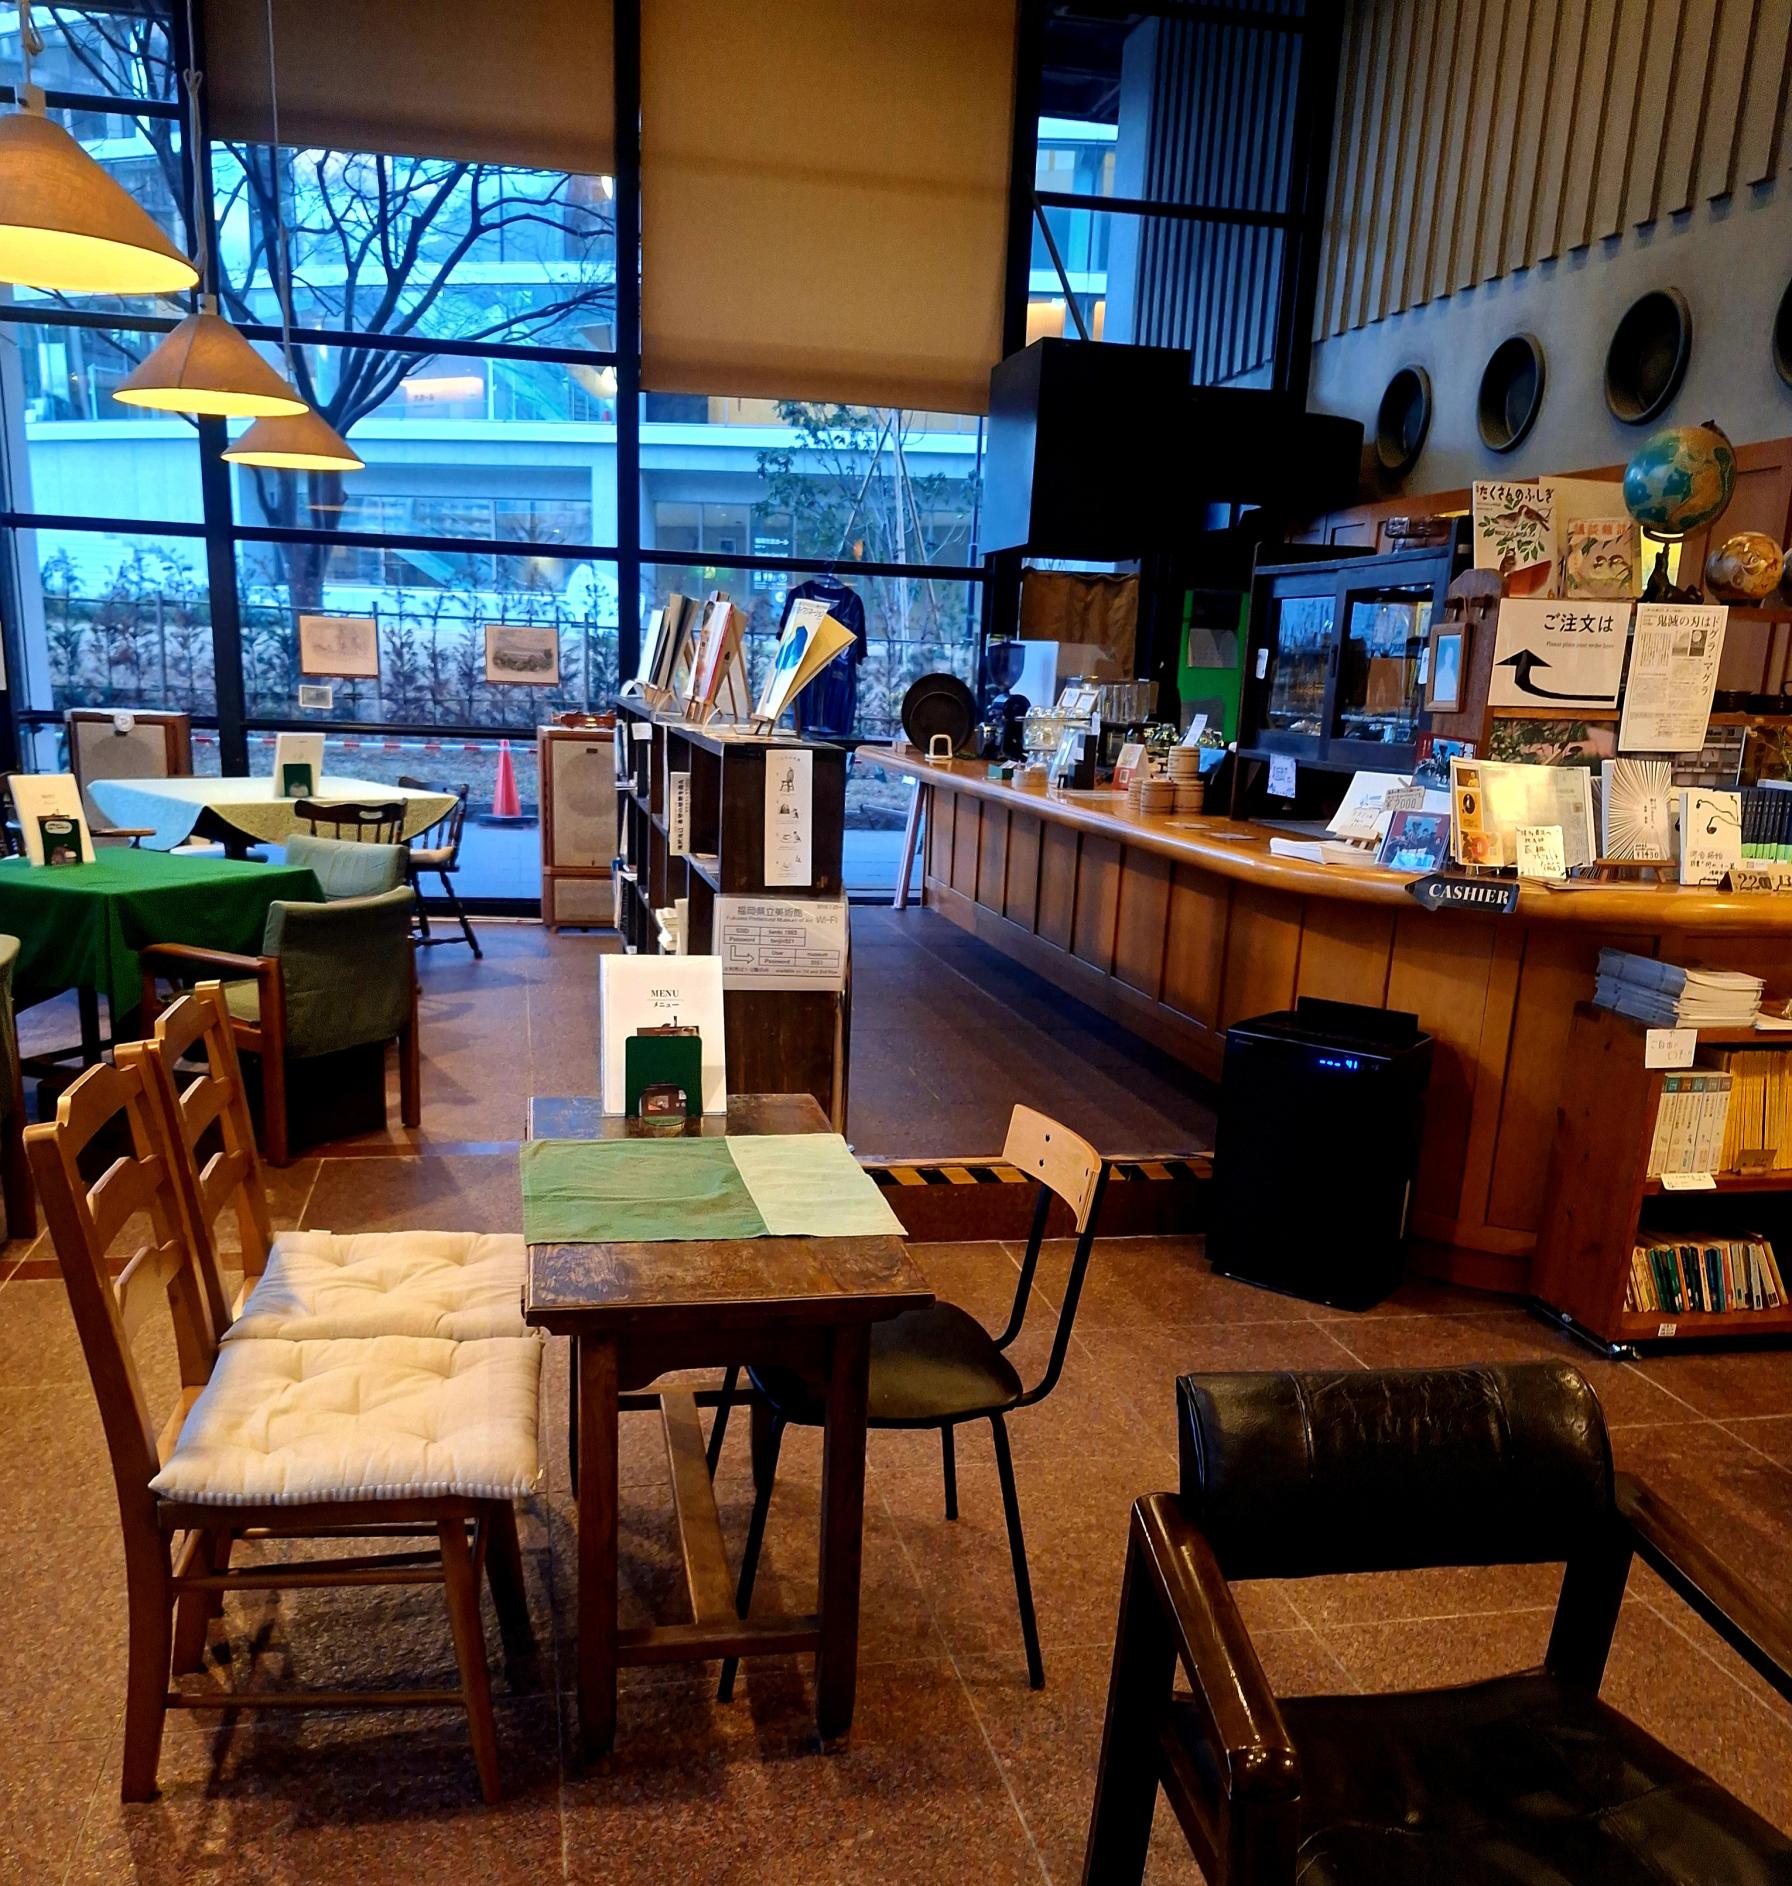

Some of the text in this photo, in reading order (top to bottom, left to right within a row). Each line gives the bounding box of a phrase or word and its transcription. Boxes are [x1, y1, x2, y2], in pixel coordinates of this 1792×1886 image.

[1479, 485, 1554, 503] たくさんのふしぎ
[1544, 612, 1614, 633] ご注文は
[1428, 883, 1510, 905] CASHIER
[815, 915, 838, 924] Wi-Fi
[650, 989, 680, 998] MENU
